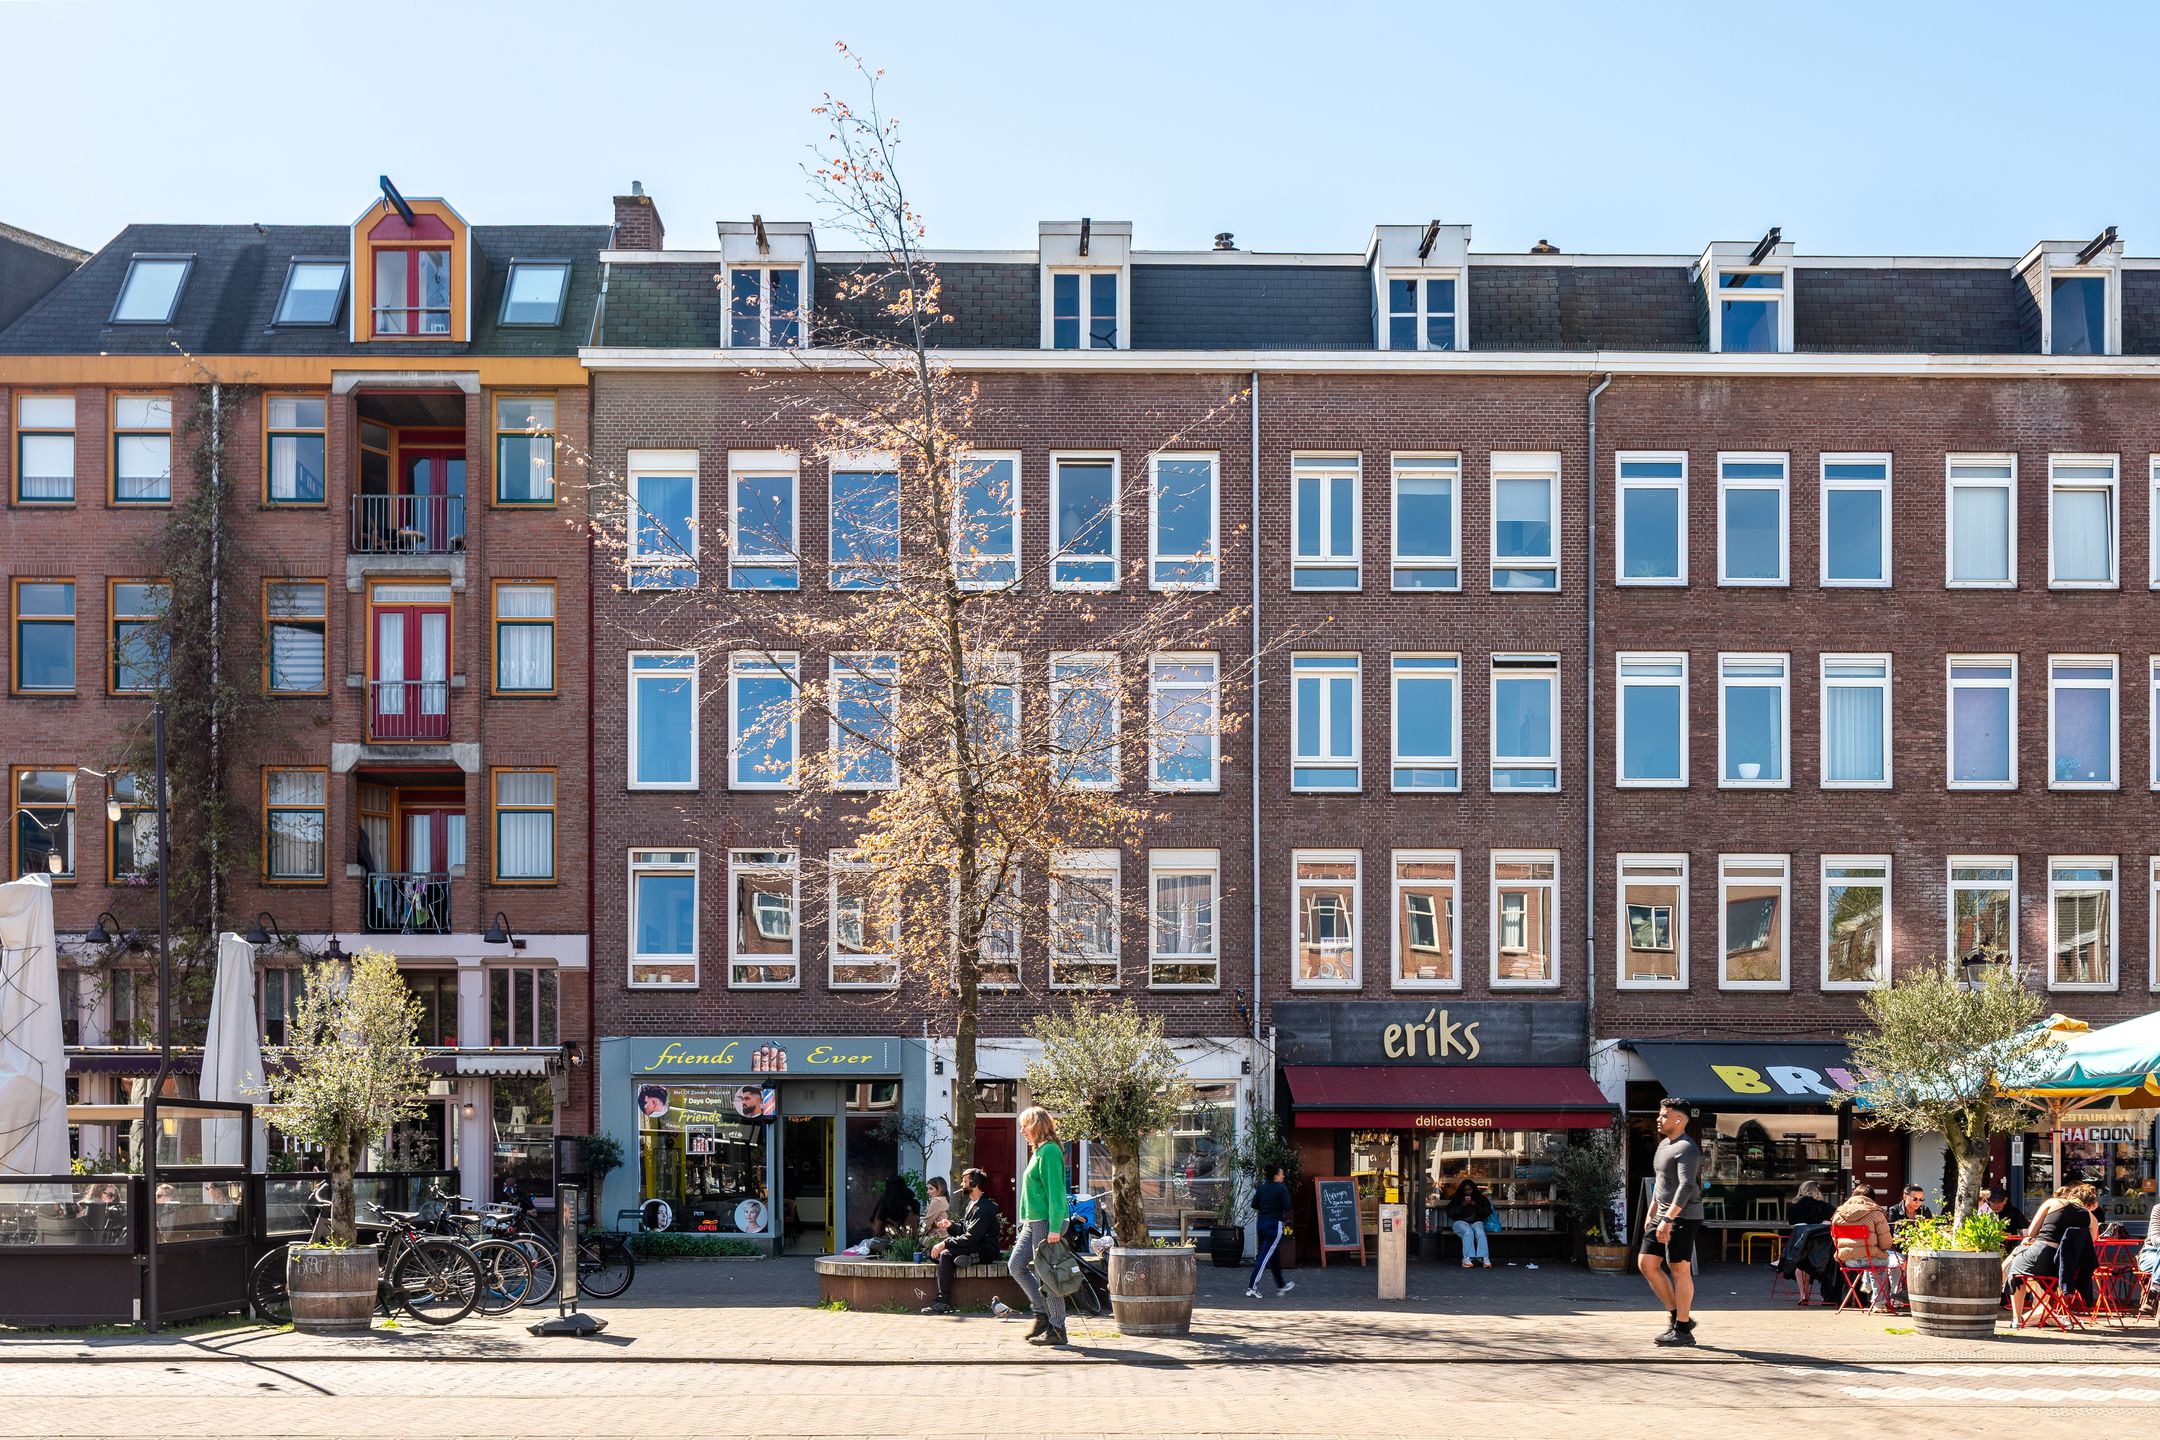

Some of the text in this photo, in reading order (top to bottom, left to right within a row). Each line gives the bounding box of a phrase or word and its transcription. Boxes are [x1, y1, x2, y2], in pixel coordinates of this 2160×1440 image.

[644, 1041, 739, 1071] friends
[806, 1045, 873, 1064] Ever
[1415, 1116, 1492, 1127] delicatessen
[2059, 1113, 2131, 1122] ESTAURANT
